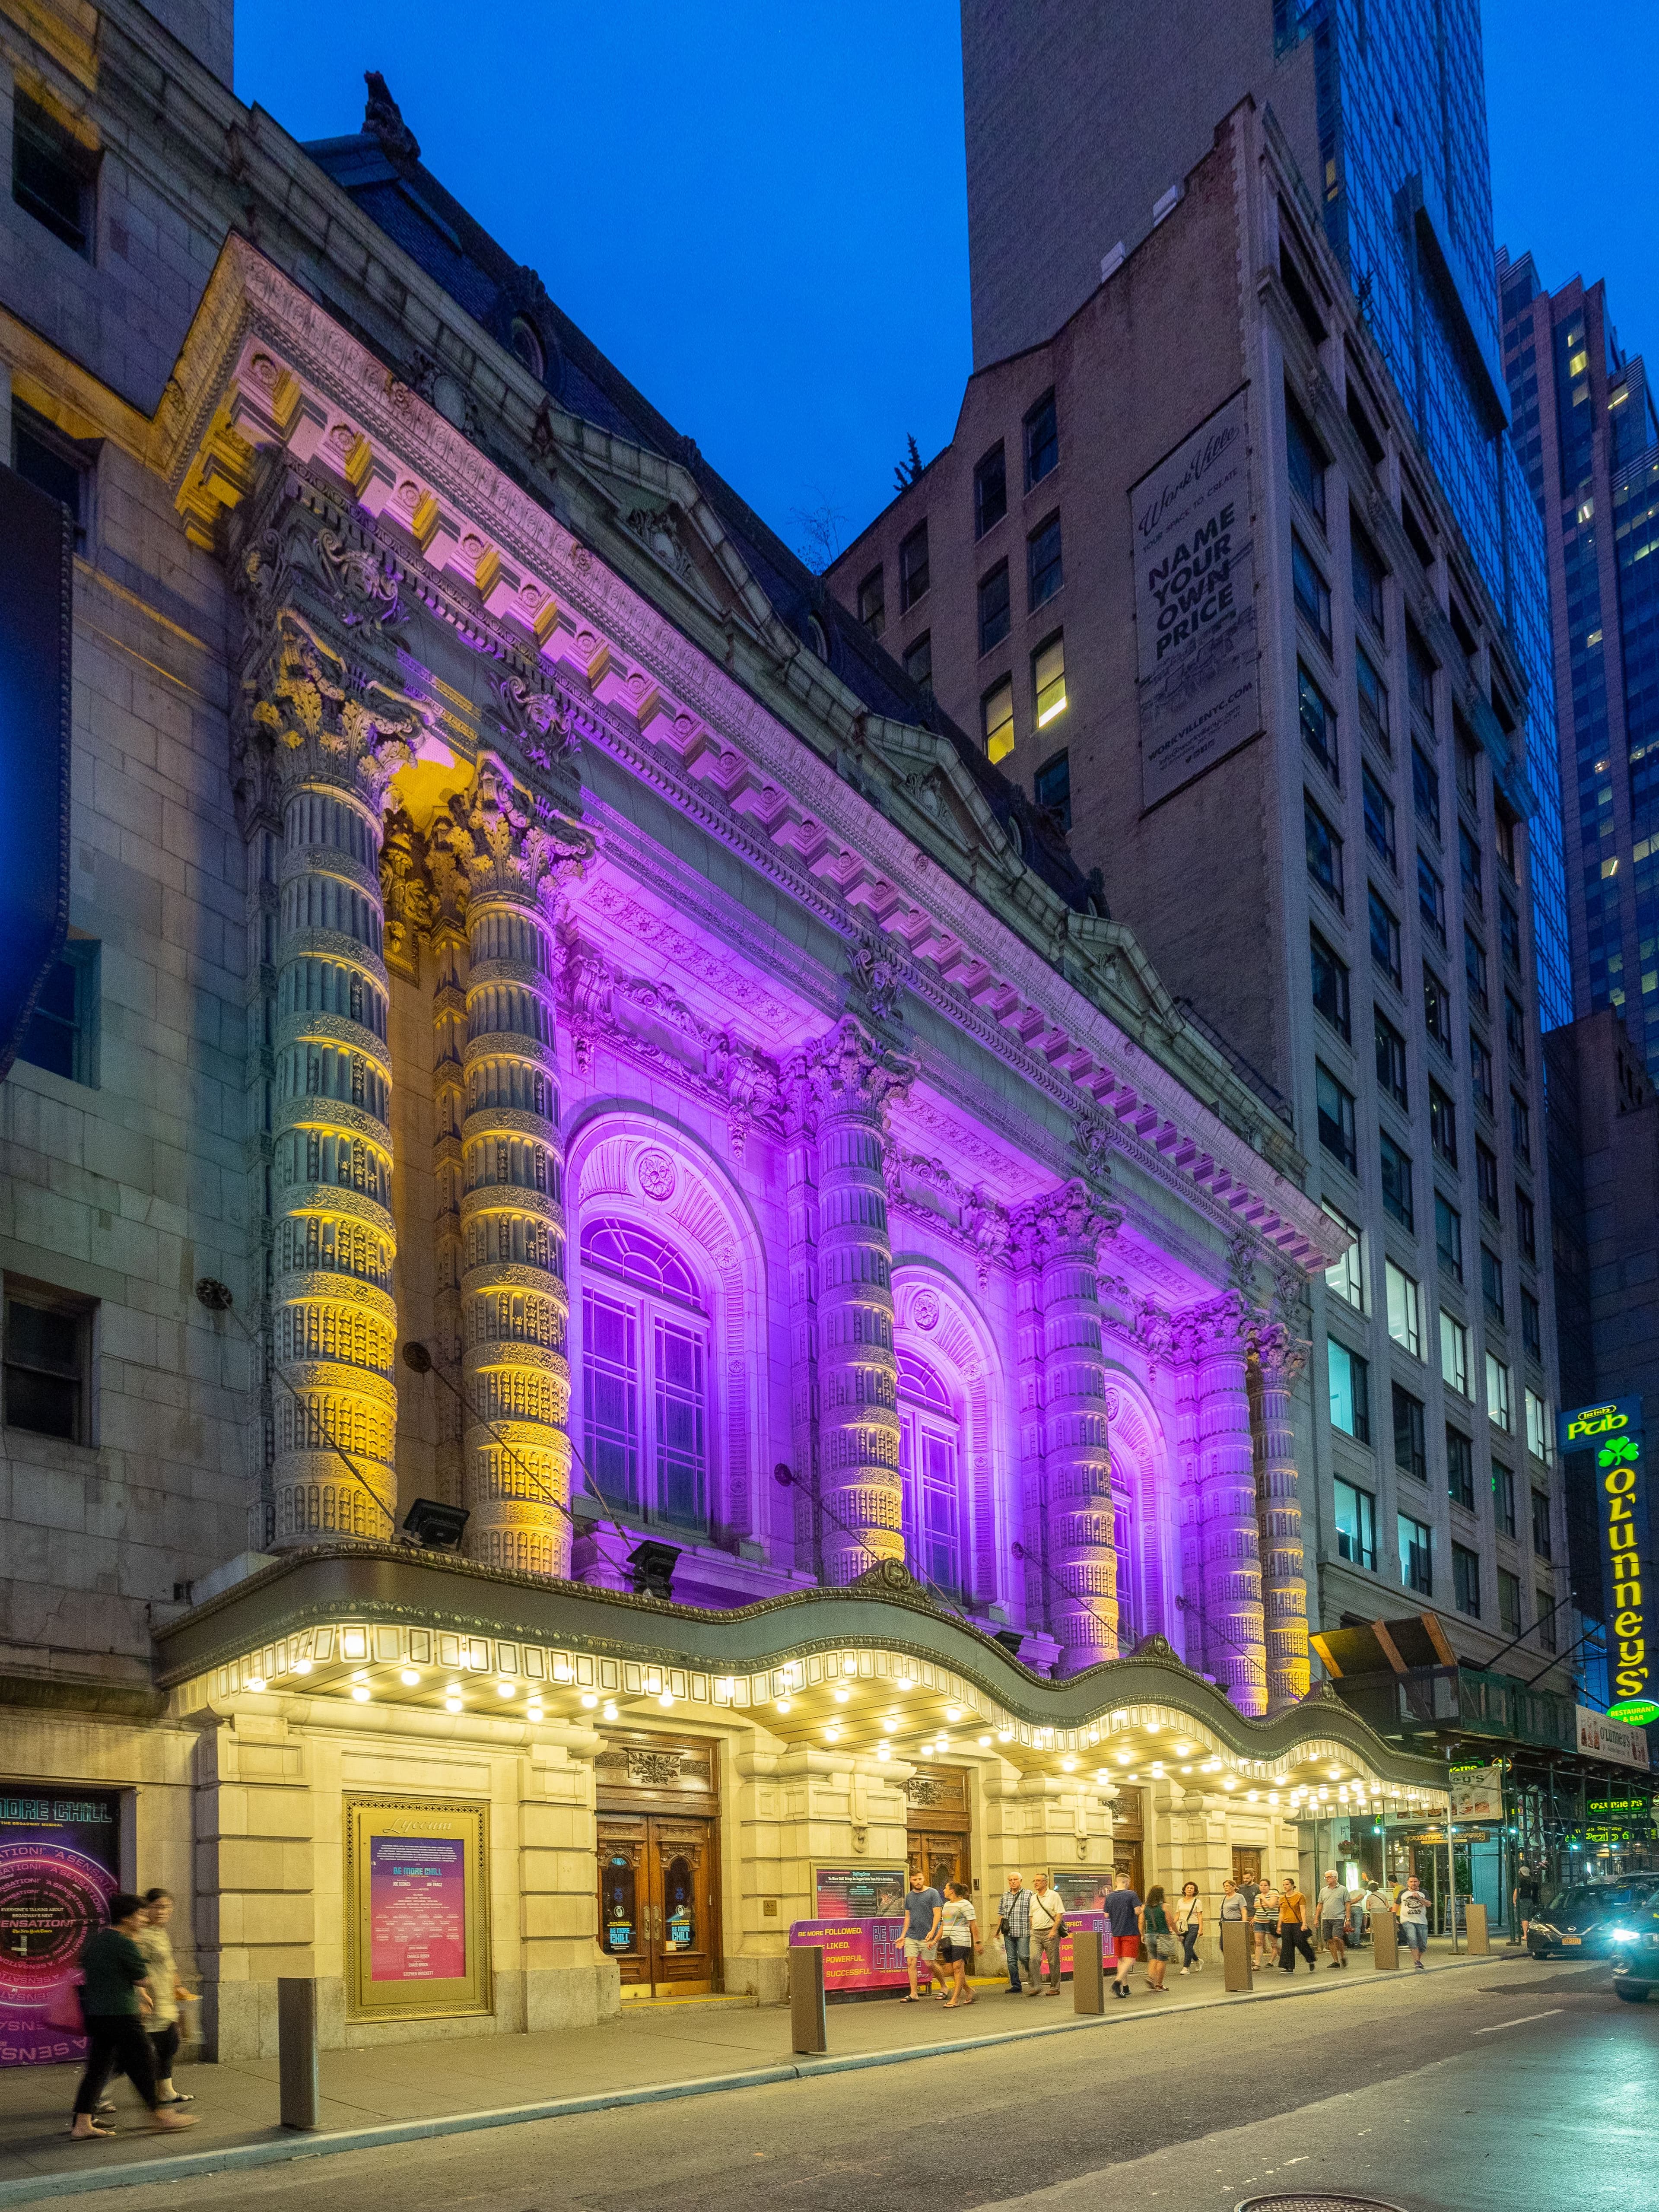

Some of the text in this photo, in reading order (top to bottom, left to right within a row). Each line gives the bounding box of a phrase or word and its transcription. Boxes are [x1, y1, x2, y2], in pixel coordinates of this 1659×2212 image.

[1143, 467, 1238, 553] YOUR SPACE TO CREATE
[1149, 502, 1235, 591] NAME
[1153, 534, 1231, 608] YOUR
[1157, 559, 1230, 631] OWN
[1156, 583, 1234, 660] PRICE
[1148, 681, 1252, 761] WORKVILLENYC.COM
[1567, 1414, 1628, 1440] Pub
[1610, 1706, 1655, 1717] RESTAURANT
[54, 1801, 112, 1823] CHILL
[383, 1818, 452, 1834] Lyceum
[672, 1932, 690, 1941] CHILL
[873, 1926, 886, 1942] BE
[1093, 1920, 1103, 1932] BE
[610, 1934, 630, 1943] CHILL
[826, 1955, 865, 1964] POWERFUL.
